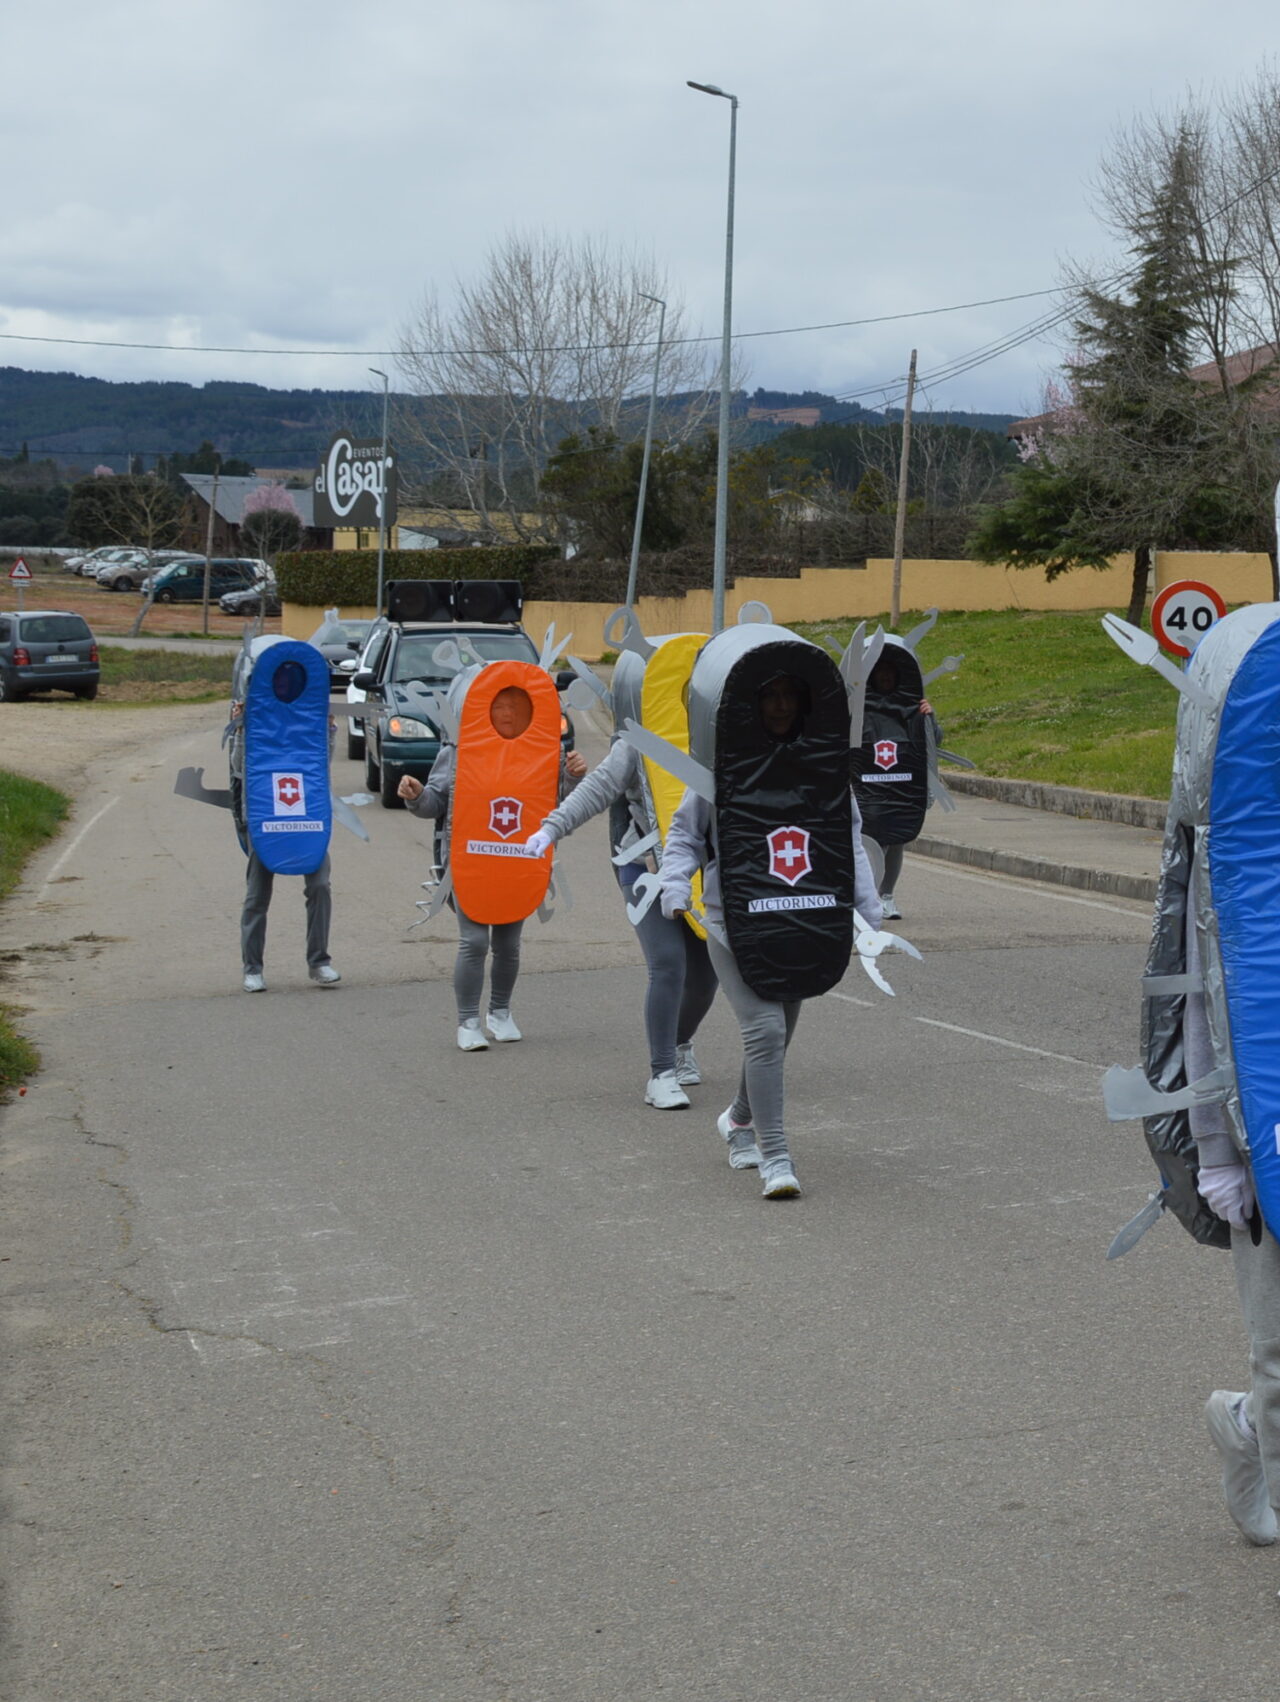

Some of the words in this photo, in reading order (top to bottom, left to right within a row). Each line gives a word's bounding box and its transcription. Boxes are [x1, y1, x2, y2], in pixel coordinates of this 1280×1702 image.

[327, 438, 393, 518] Casar
[1166, 606, 1213, 631] 40
[264, 822, 321, 832] VICTORINOX
[750, 895, 835, 911] VICTORINOX
